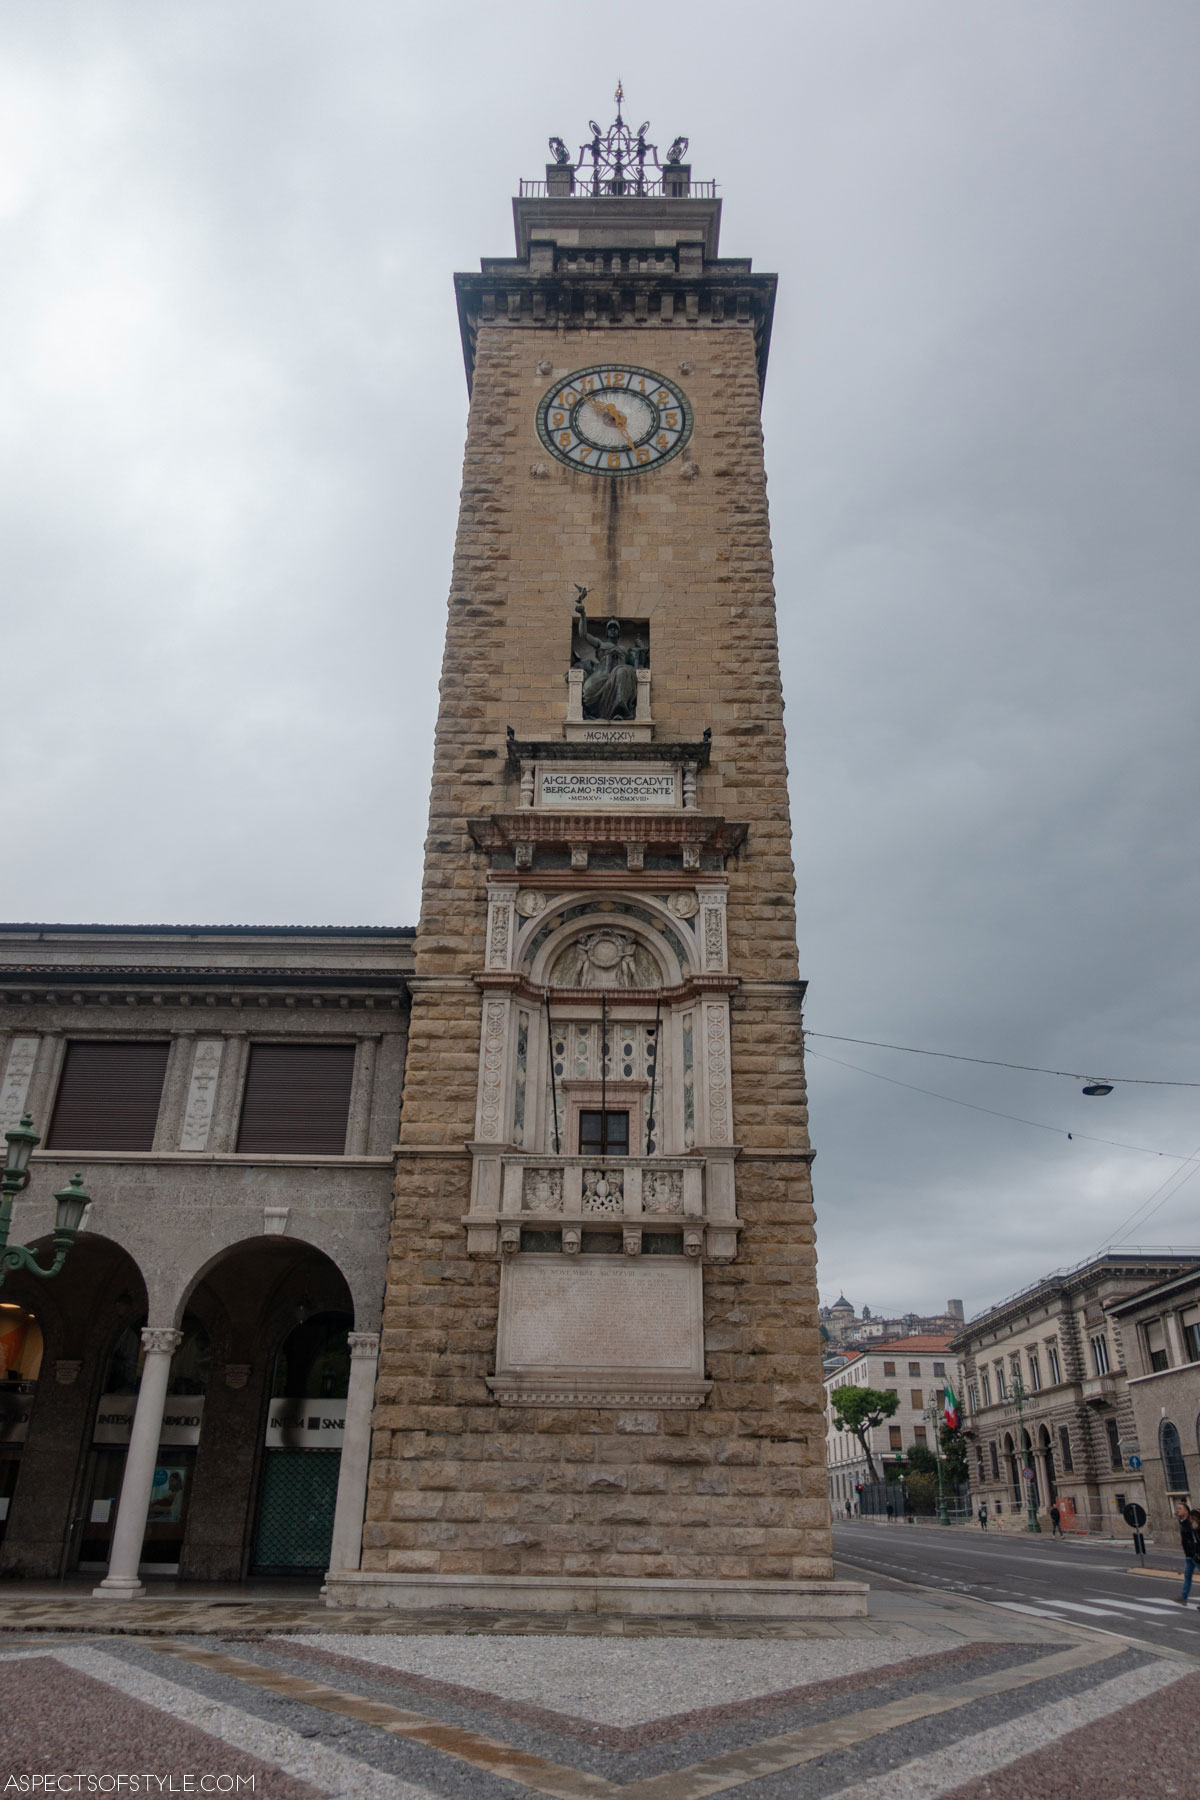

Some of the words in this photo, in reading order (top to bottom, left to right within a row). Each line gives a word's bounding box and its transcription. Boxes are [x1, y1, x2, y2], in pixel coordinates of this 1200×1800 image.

[579, 377, 595, 390] 11
[604, 373, 625, 387] 12
[639, 378, 646, 391] 1
[557, 391, 577, 407] 10
[656, 391, 670, 405] 2
[552, 412, 565, 426] 9
[665, 412, 678, 426] 3
[559, 432, 571, 447] 8
[656, 433, 669, 448] 4
[580, 448, 593, 462] 7
[607, 452, 620, 468] 6
[636, 448, 650, 463] 5
